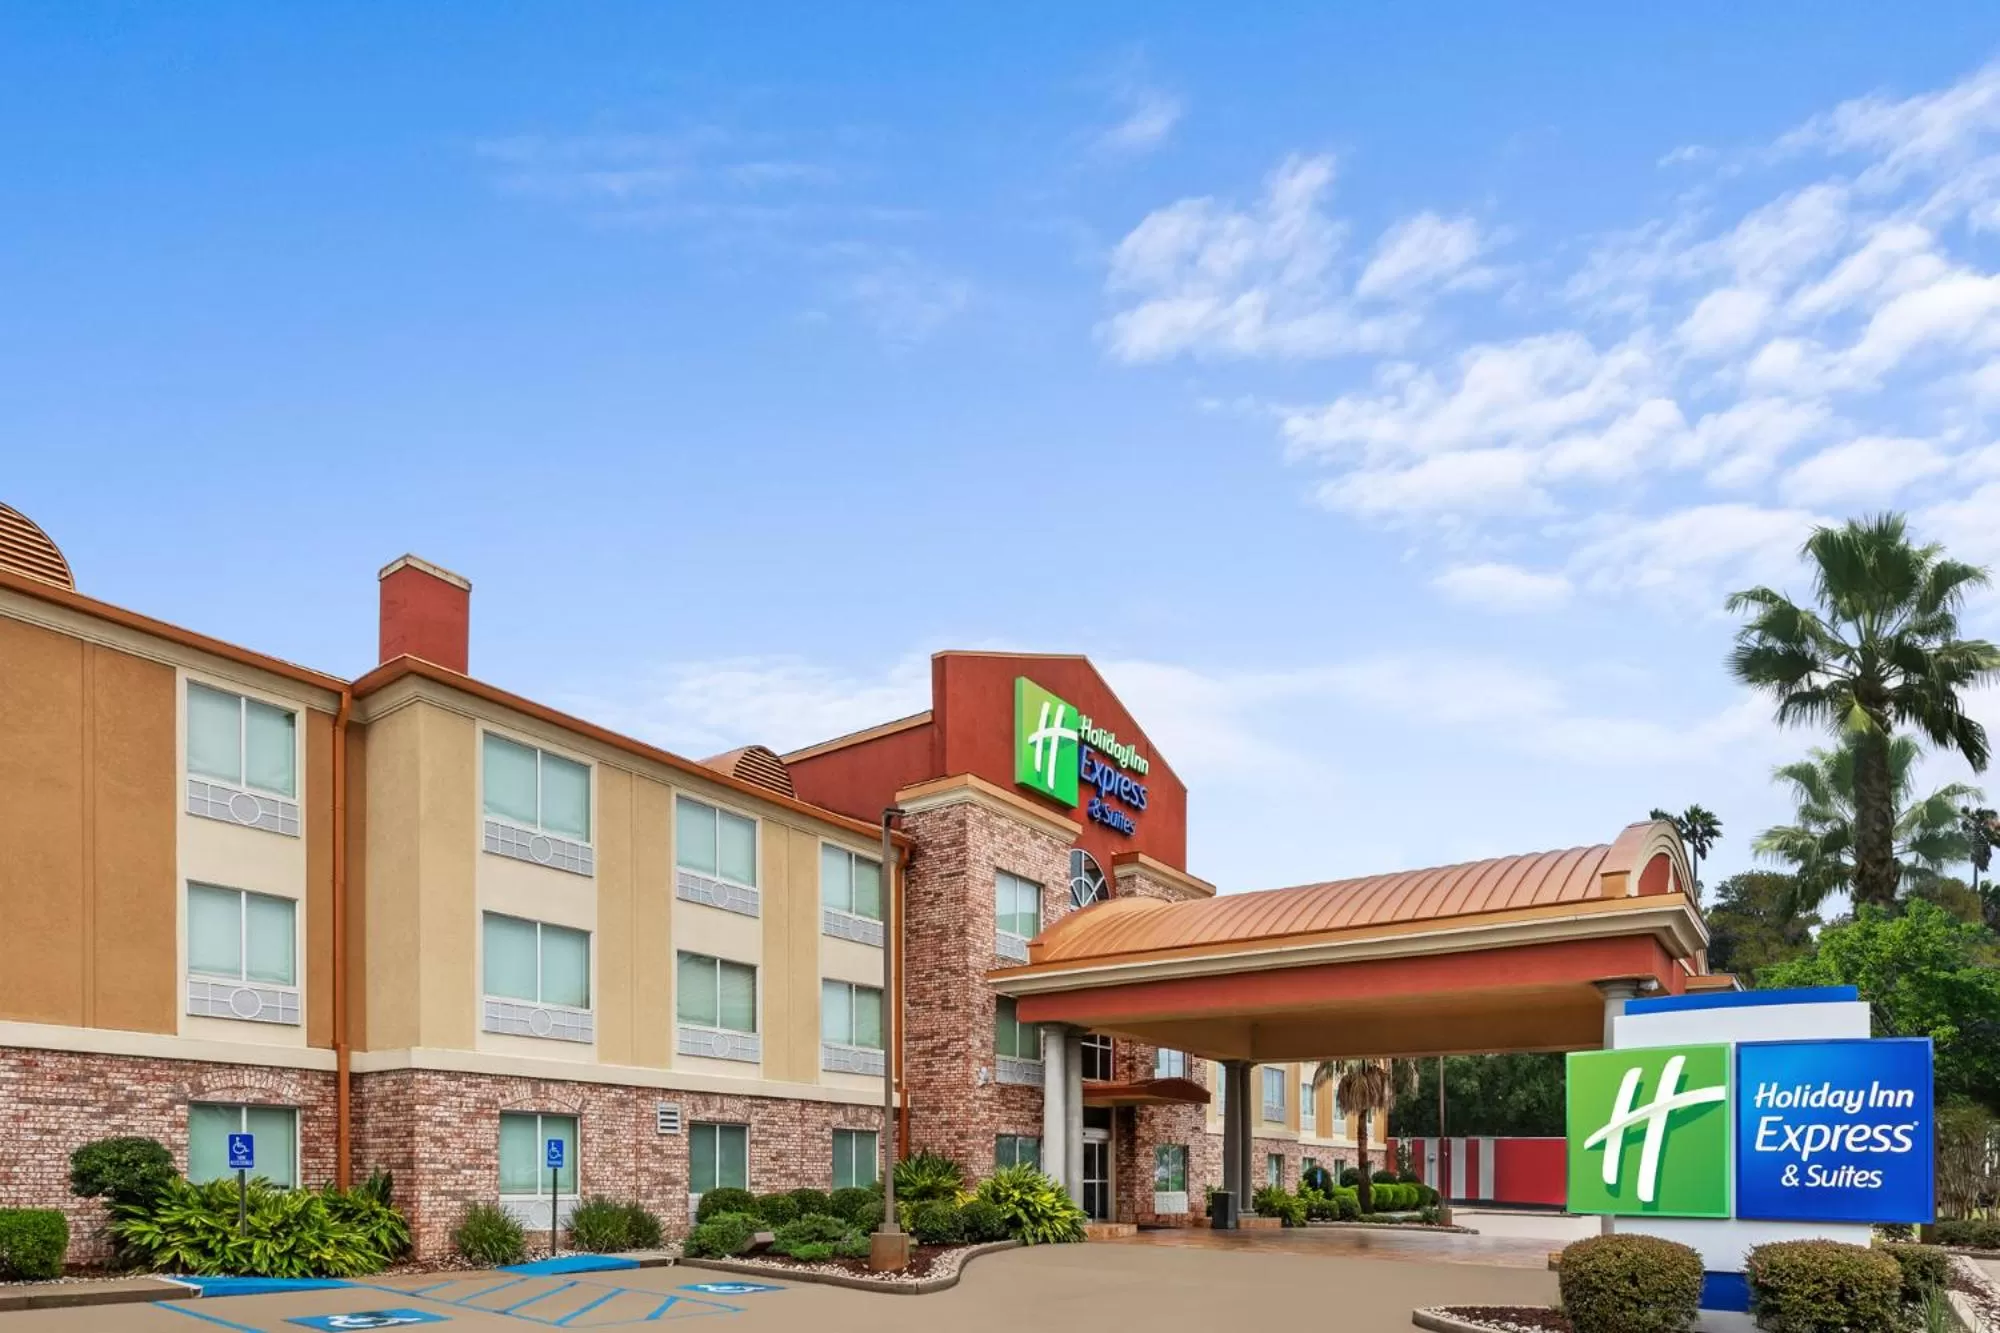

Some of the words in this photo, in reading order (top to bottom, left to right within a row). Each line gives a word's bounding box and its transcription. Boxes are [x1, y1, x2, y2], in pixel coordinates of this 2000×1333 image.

[1079, 715, 1131, 768] Holiday
[1131, 746, 1148, 775] Inn
[1080, 745, 1148, 810] Express
[1089, 799, 1102, 821] &
[1103, 802, 1136, 836] Suites
[1754, 1082, 1865, 1114] Holiday
[1869, 1081, 1914, 1108] Inn
[1754, 1116, 1915, 1161] Express
[1780, 1164, 1800, 1187] &
[1804, 1165, 1883, 1188] Suites
